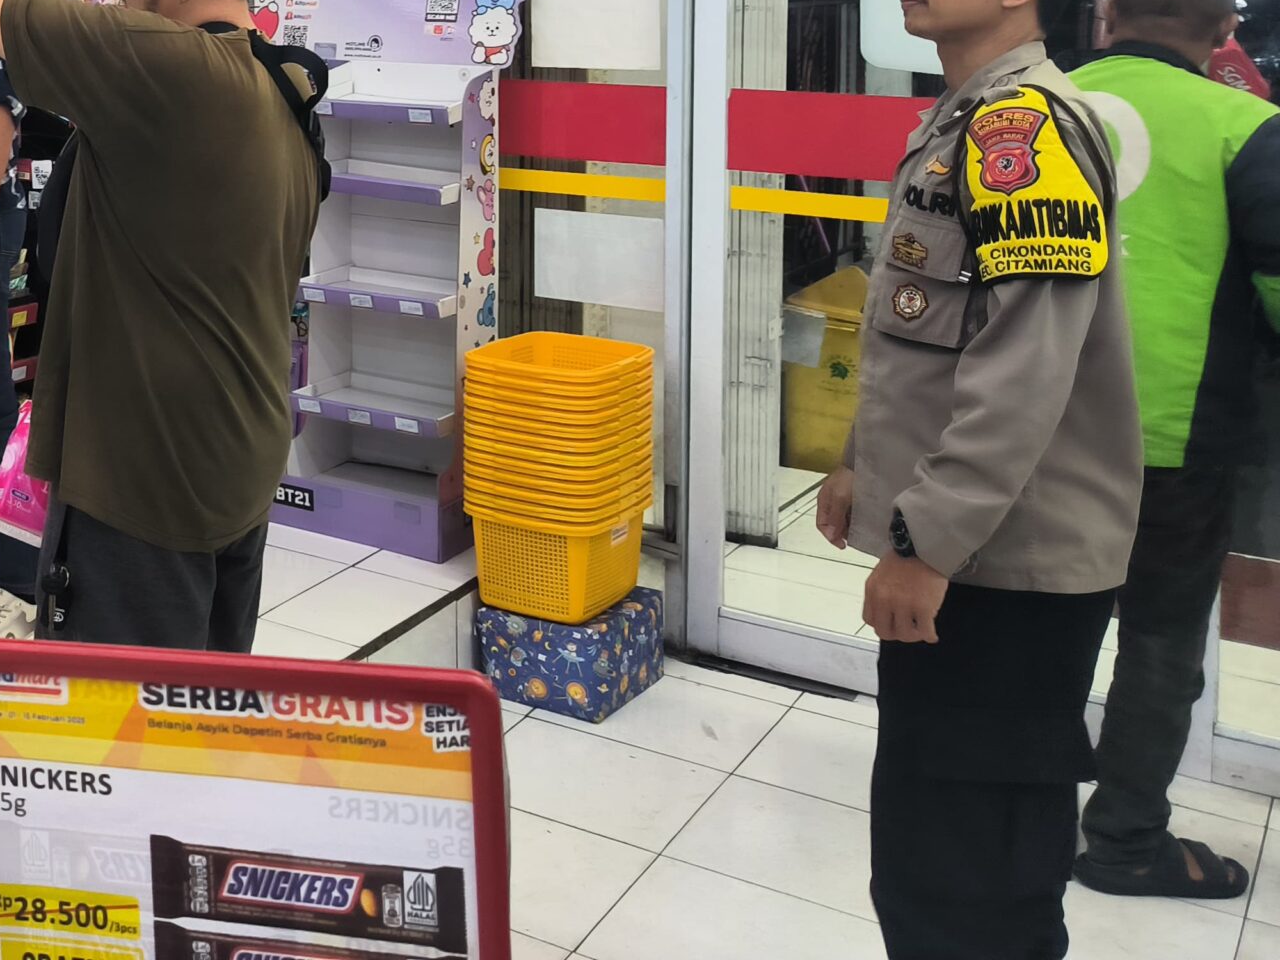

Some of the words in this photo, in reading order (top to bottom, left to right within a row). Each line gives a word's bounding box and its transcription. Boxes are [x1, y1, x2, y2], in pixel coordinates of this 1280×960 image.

[974, 112, 1034, 132] POLRES
[1013, 119, 1030, 128] KOTA
[990, 244, 1091, 260] CIKONDANG
[995, 259, 1091, 273] CITAMIANG
[275, 487, 311, 507] BT21
[141, 682, 264, 713] SERBA
[271, 691, 410, 725] GRATIS
[147, 718, 193, 732] Belanja
[196, 722, 229, 735] Asyik
[232, 724, 282, 738] Dapetin
[286, 728, 322, 741] Serba
[326, 732, 387, 748] Gratisnya
[228, 865, 355, 908] SNICKERS
